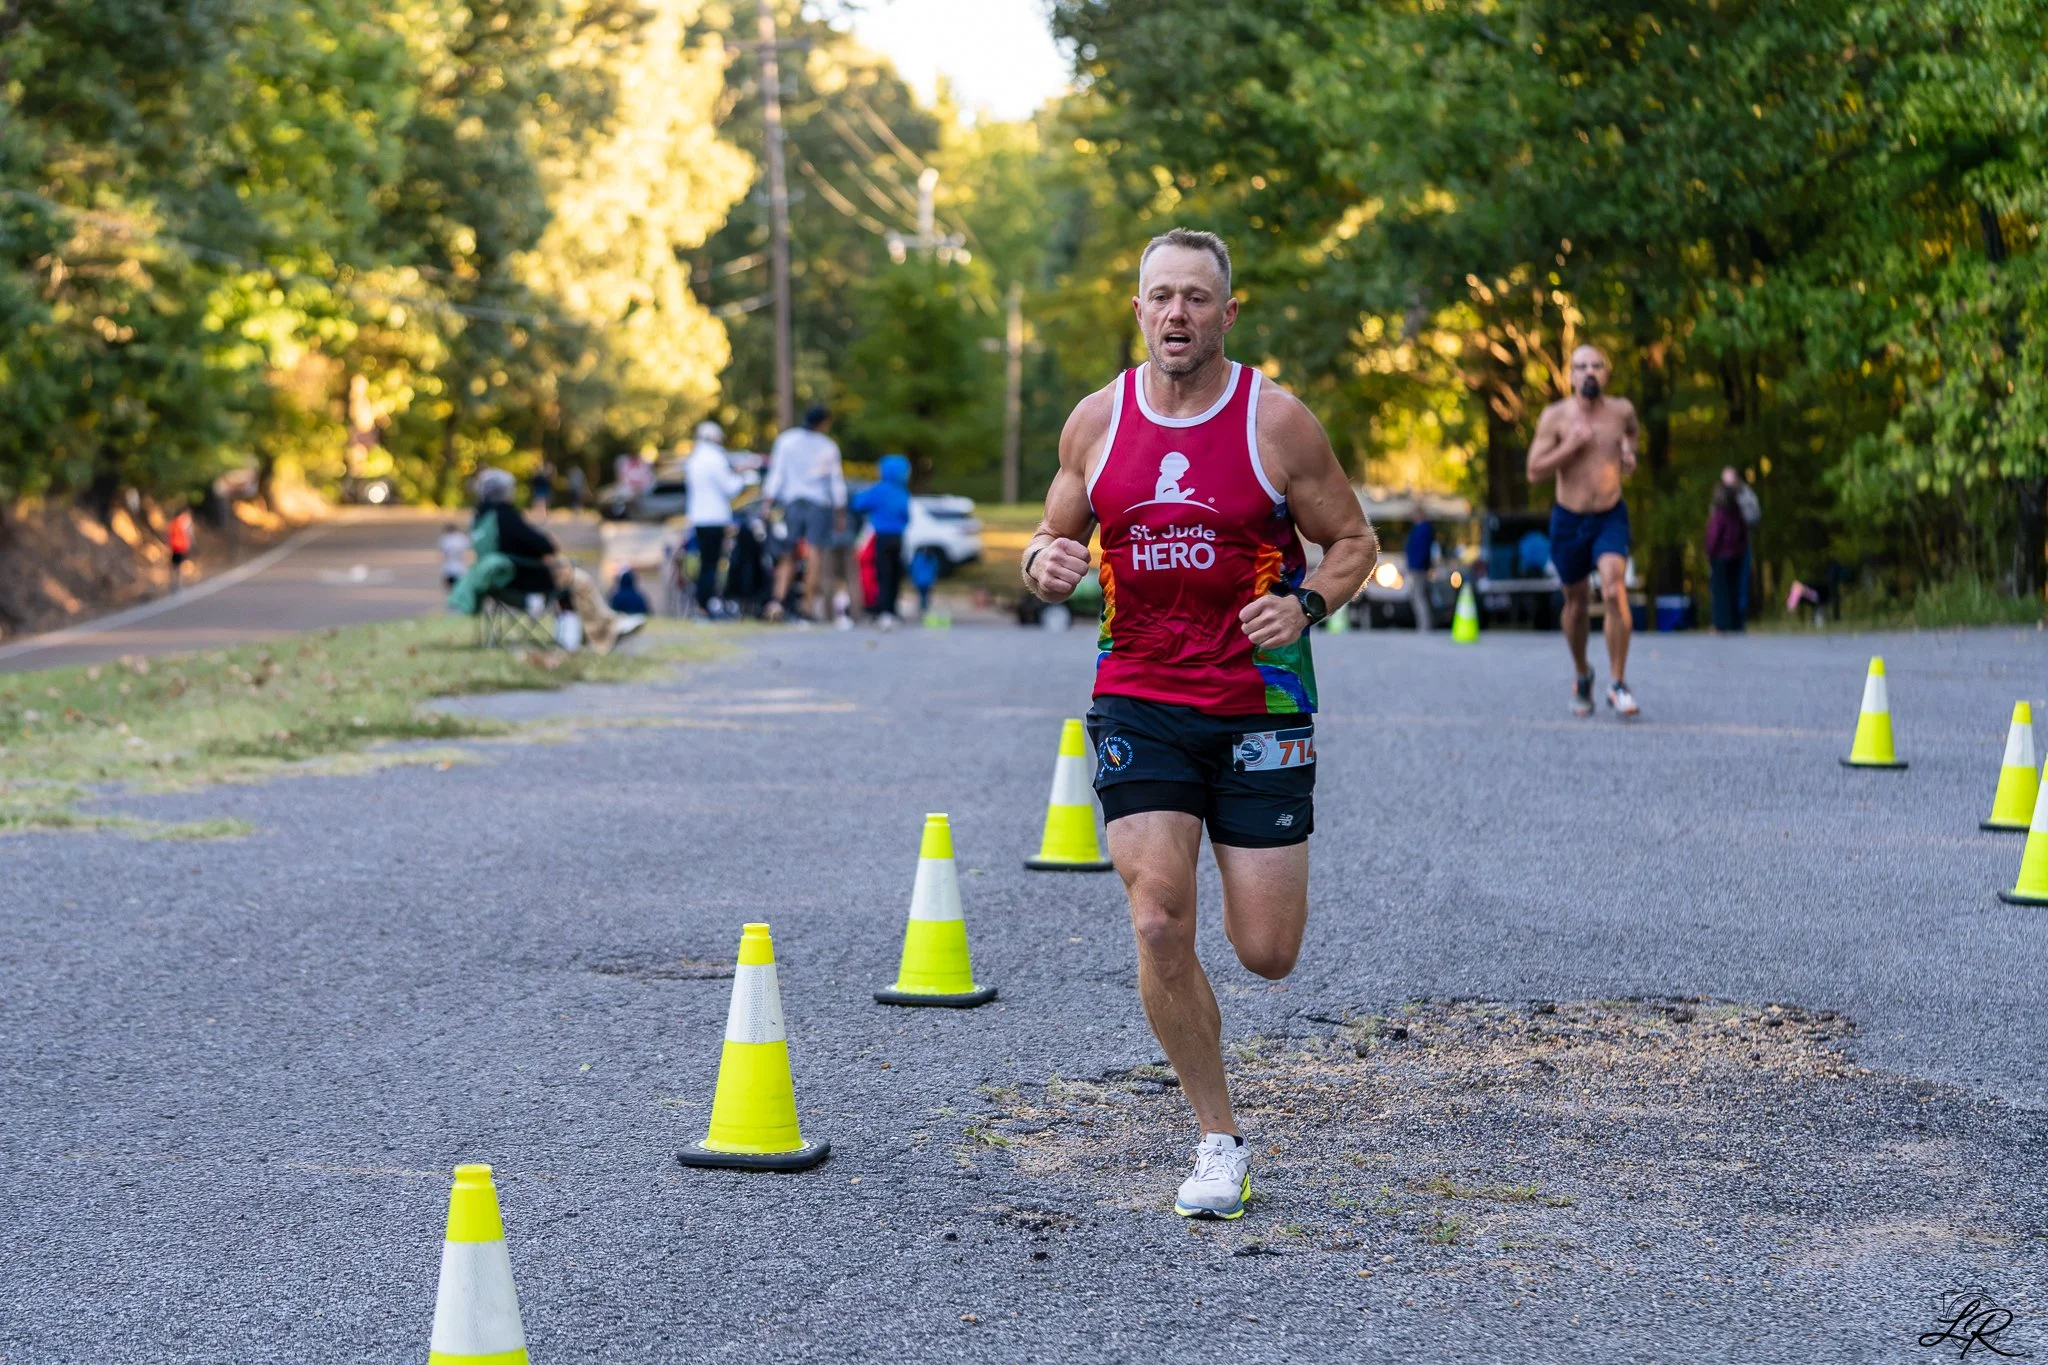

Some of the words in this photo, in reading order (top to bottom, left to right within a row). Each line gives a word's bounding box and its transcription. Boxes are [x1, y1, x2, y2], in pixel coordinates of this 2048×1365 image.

[1129, 525, 1157, 540] St.
[1161, 524, 1216, 541] Jude
[1132, 542, 1216, 571] HERO
